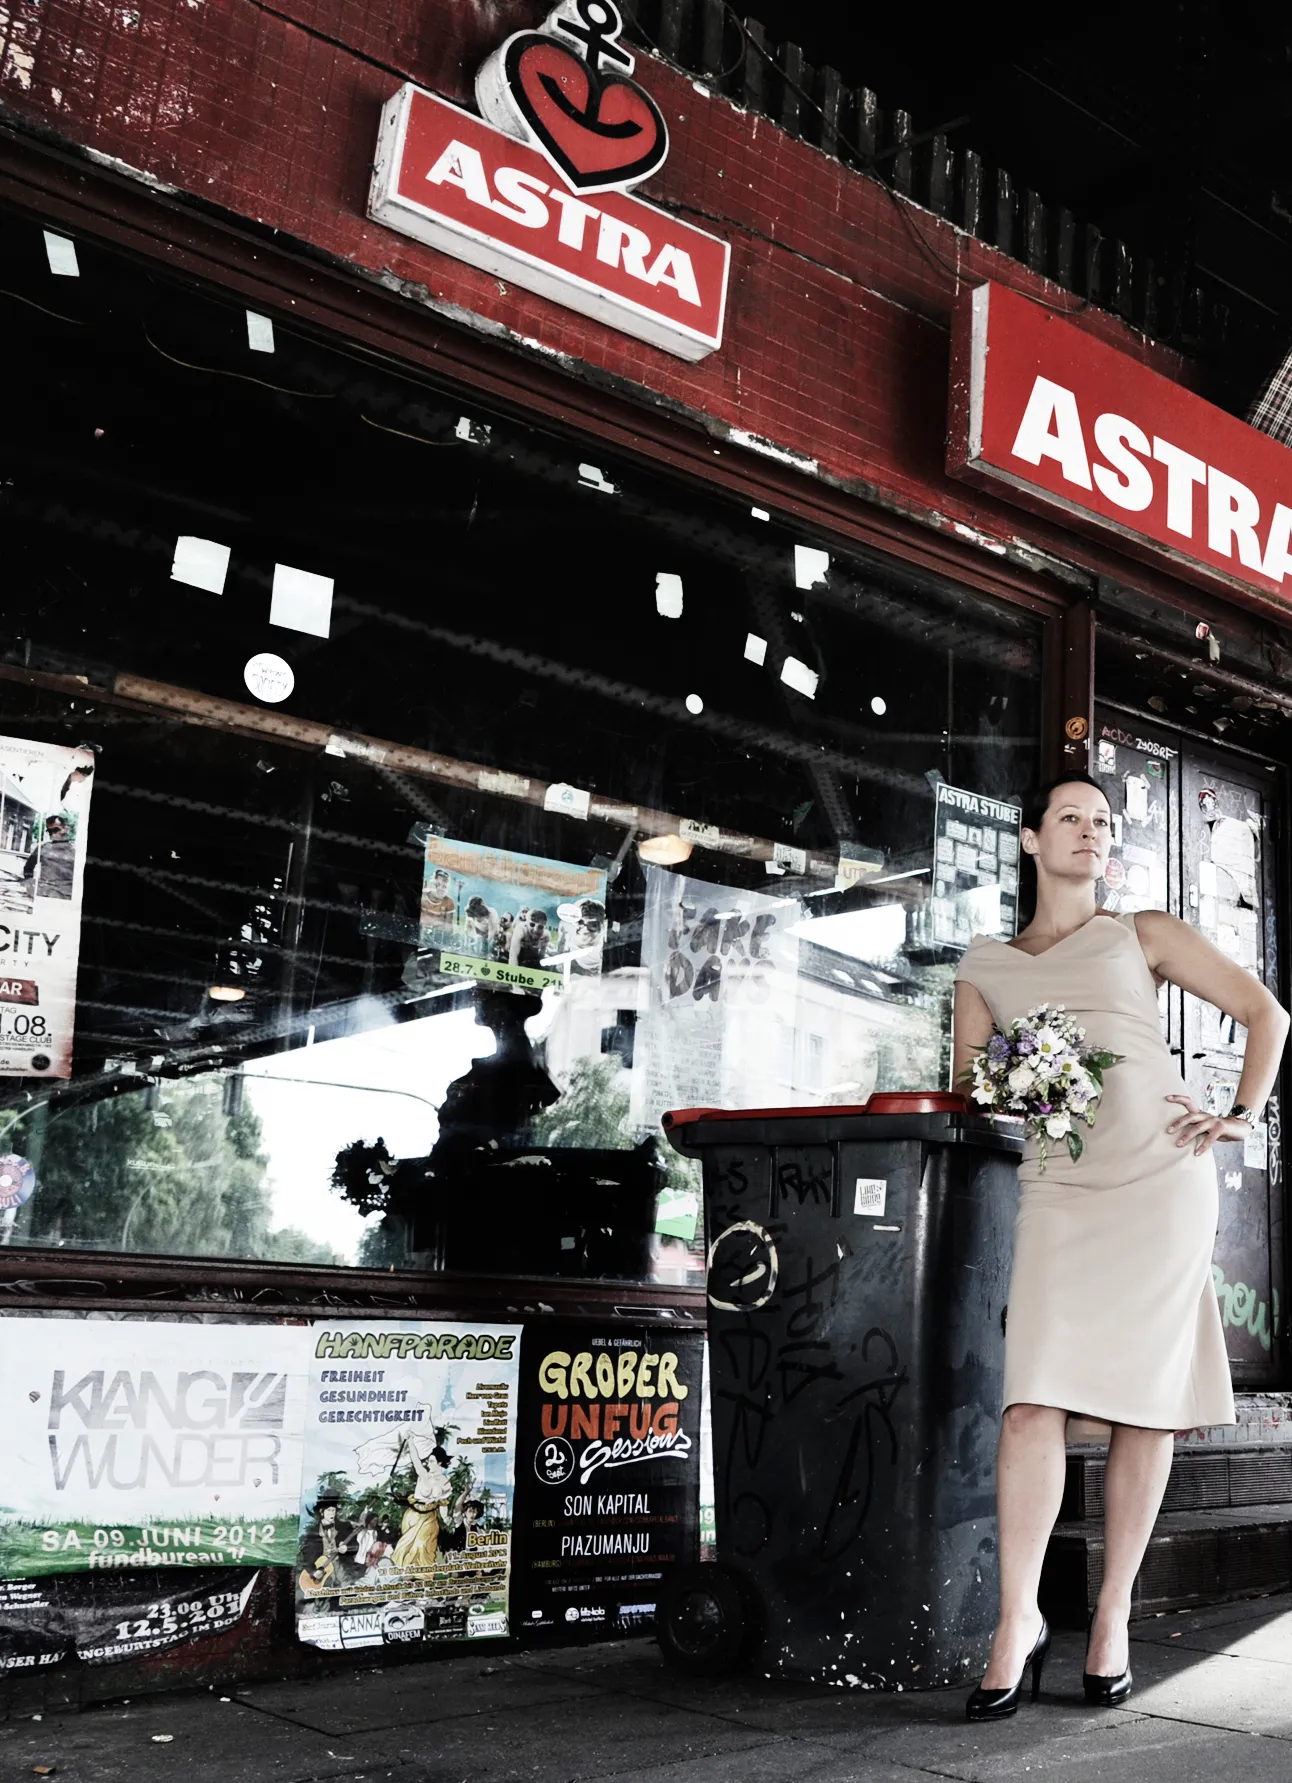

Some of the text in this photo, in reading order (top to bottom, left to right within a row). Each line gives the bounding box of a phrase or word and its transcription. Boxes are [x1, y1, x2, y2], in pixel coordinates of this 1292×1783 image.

[425, 139, 703, 308] ASTRA
[939, 787, 1019, 825] ASTRA STUBE
[667, 901, 776, 960] FAKE
[444, 960, 477, 976] 28.7.
[496, 970, 534, 985] Stube
[665, 951, 777, 1005] DAYS
[0, 981, 23, 996] AR
[0, 1034, 52, 1044] STAGE CLUB
[315, 1332, 516, 1360] HANFPARADE
[320, 1370, 386, 1383] FREIHEIT
[538, 1351, 689, 1400] GROBER
[319, 1390, 408, 1403] GESUNDHEIT
[318, 1409, 425, 1423] GERECHTIGKEIT
[541, 1402, 679, 1440] UNFUG
[48, 1434, 282, 1491] WUNDER
[579, 1427, 692, 1485] Sessions
[564, 1493, 650, 1516] SON KAPITAL
[42, 1530, 81, 1551] SA
[213, 1524, 275, 1544] 2012
[467, 1531, 508, 1548] Berlin
[561, 1532, 650, 1556] PIAZUMANJU
[88, 1547, 224, 1569] fundbureau
[461, 1551, 486, 1560] August
[7, 1583, 36, 1591] Berger
[10, 1592, 42, 1600] Wegner
[115, 1599, 243, 1641] 12.5.201
[146, 1601, 203, 1620] 23.00
[192, 1620, 210, 1634] IM
[213, 1613, 243, 1629] DOC
[342, 1615, 381, 1634] CANNA
[387, 1630, 421, 1641] DINAFEM
